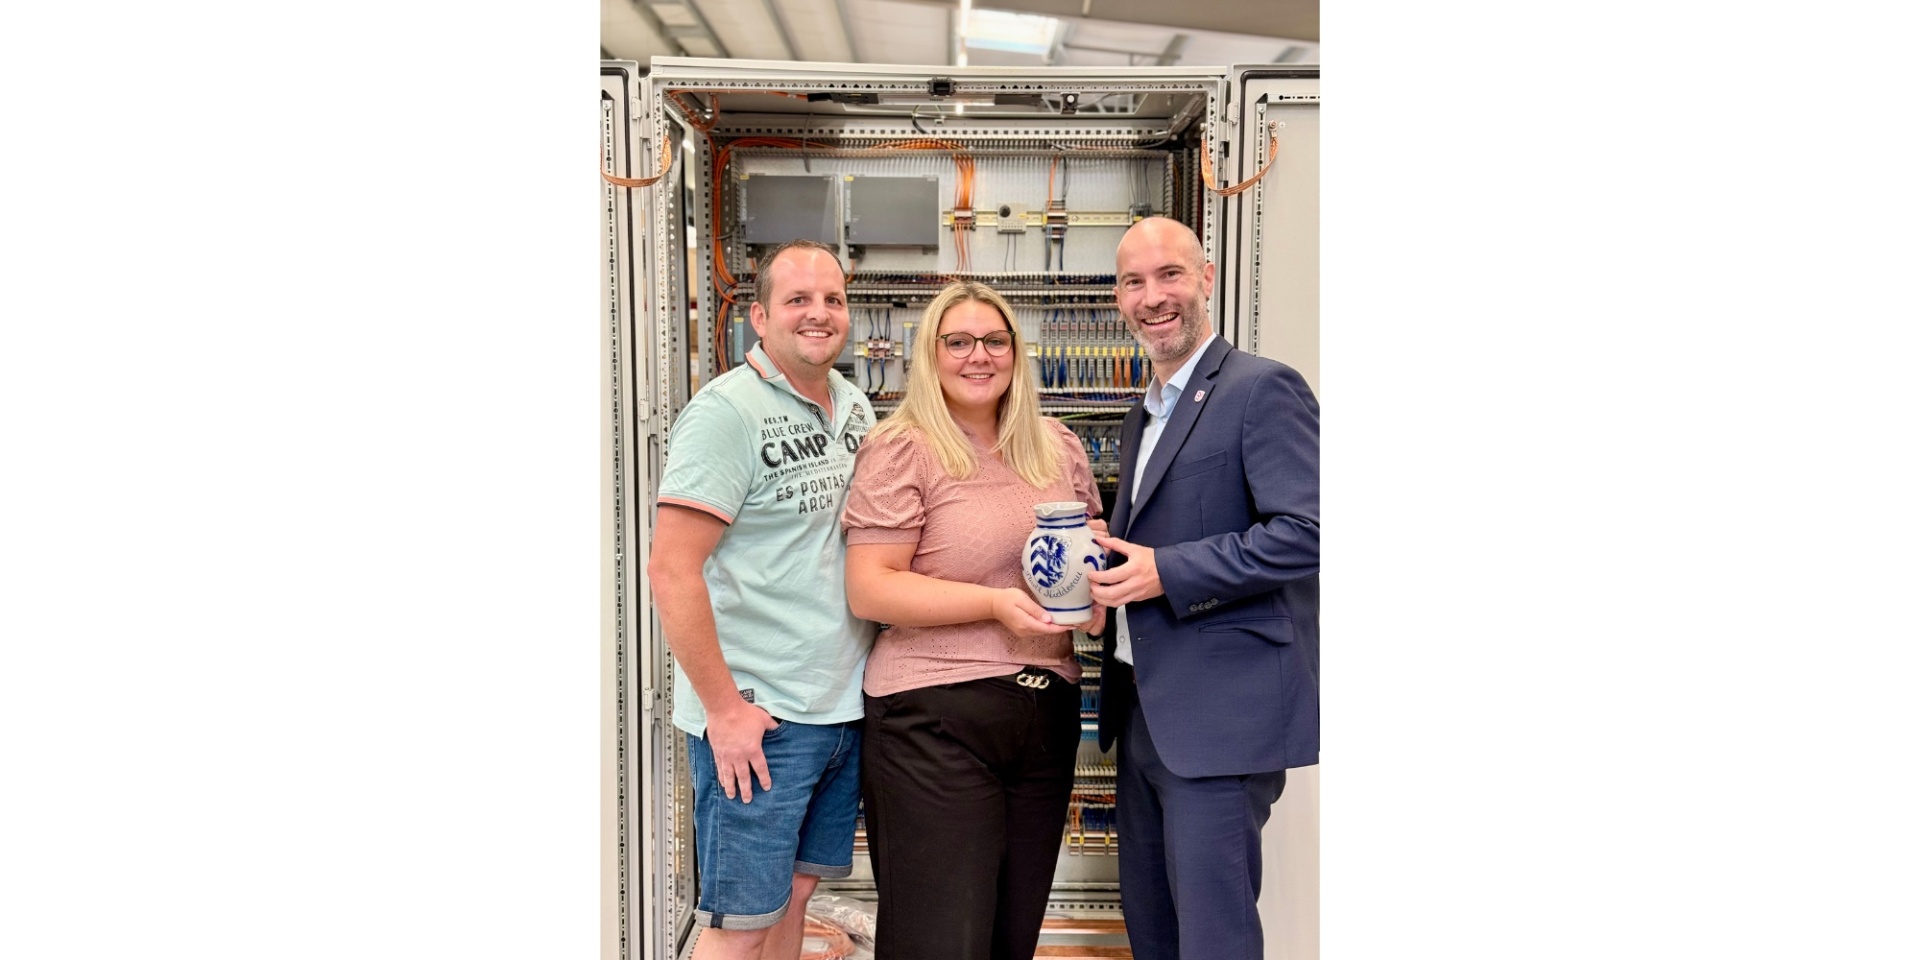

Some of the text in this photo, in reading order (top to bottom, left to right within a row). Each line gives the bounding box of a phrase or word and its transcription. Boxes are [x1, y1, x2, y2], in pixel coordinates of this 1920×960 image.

[761, 422, 814, 440] BLUE CREW
[761, 433, 828, 468] CAMP
[763, 471, 779, 482] THE
[780, 463, 807, 476] SPANISH
[808, 458, 830, 469] ISLAND
[776, 485, 794, 502] ES
[798, 493, 834, 514] ARCH
